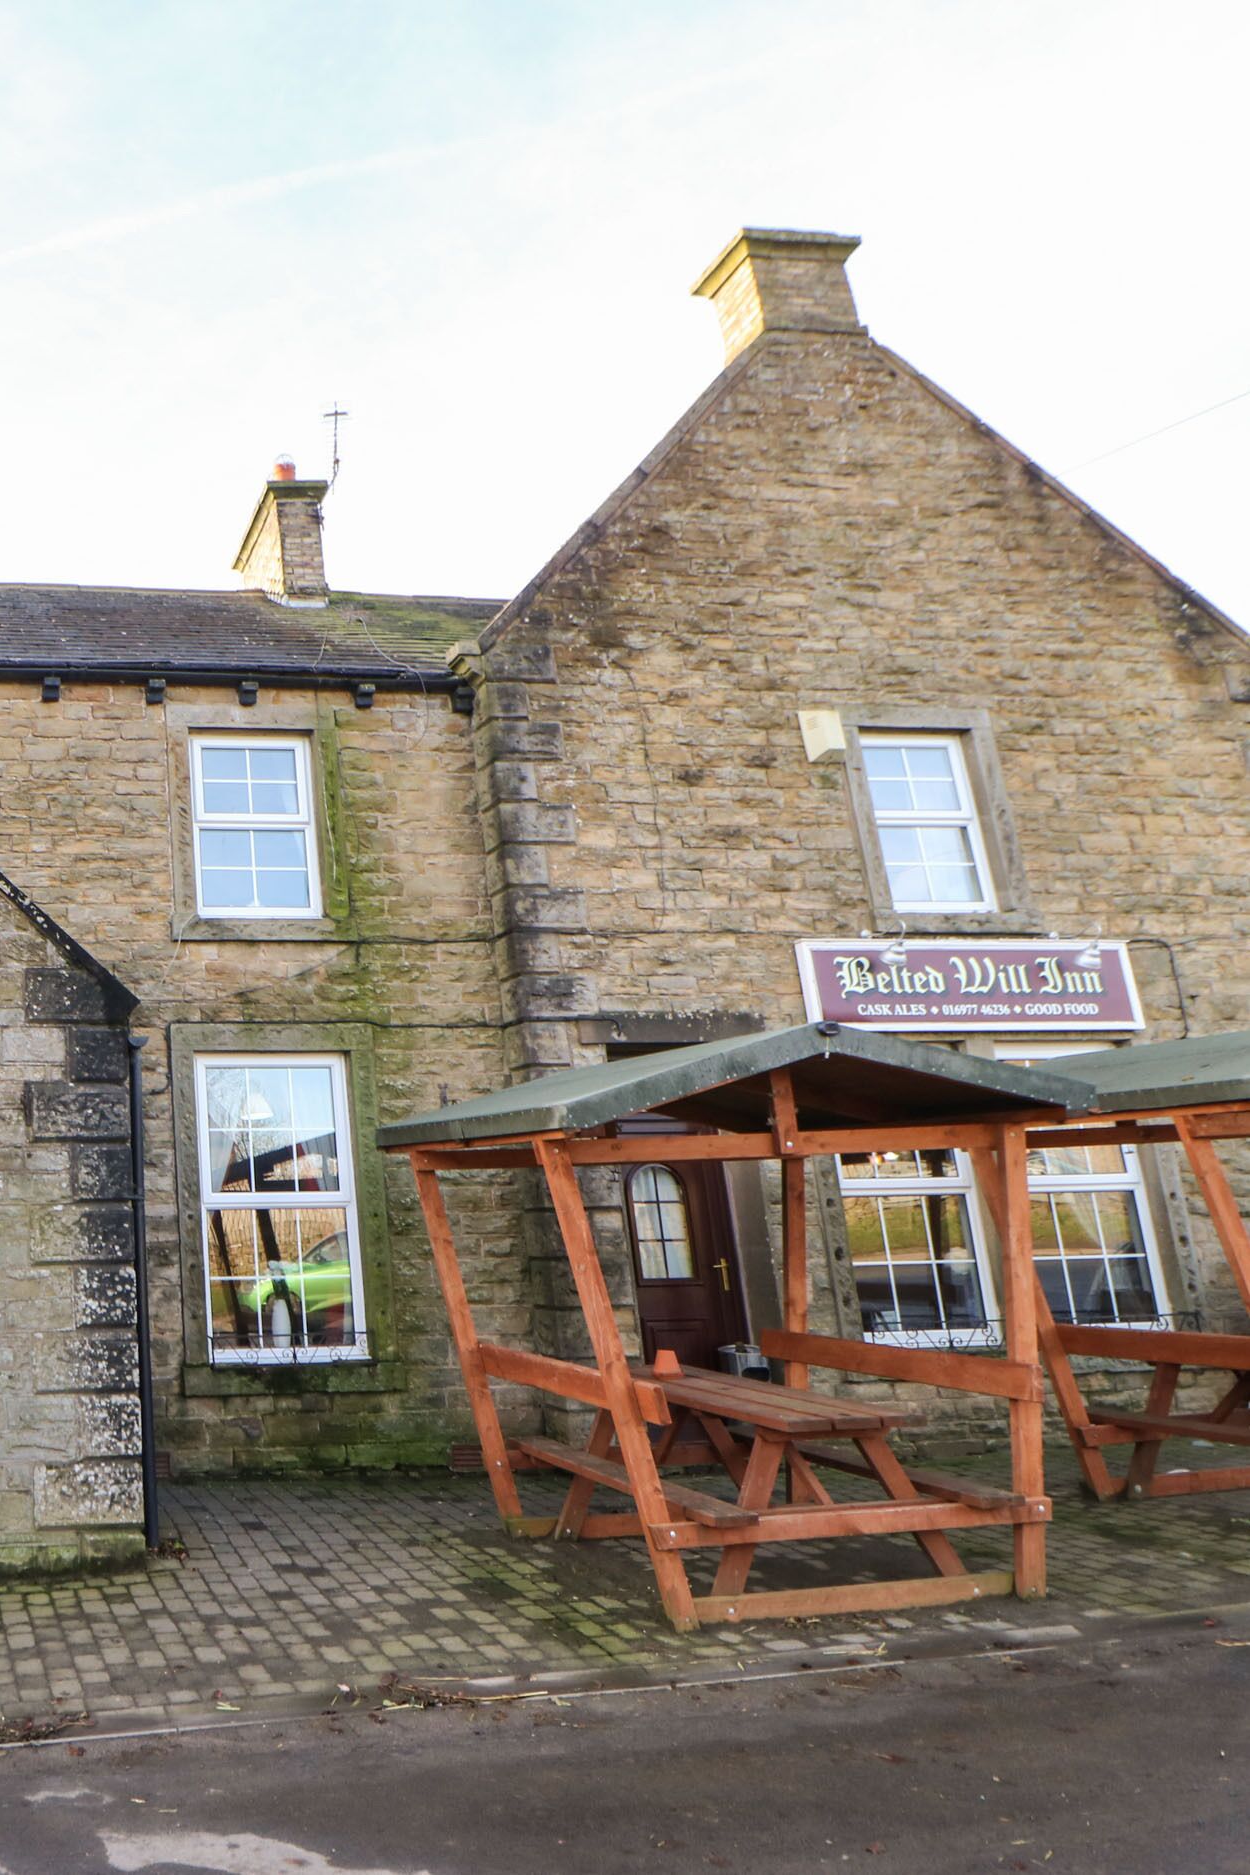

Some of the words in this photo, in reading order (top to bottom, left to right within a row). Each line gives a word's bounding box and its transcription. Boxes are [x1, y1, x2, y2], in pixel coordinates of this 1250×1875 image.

[833, 957, 946, 998] Belted
[950, 957, 1032, 993] Will
[1035, 957, 1103, 993] Inn
[857, 1003, 893, 1016] CASK
[894, 1004, 927, 1016] ALES
[942, 1004, 977, 1015] 016977
[1024, 1003, 1062, 1016] GOOD
[1063, 1003, 1099, 1016] FOOD
